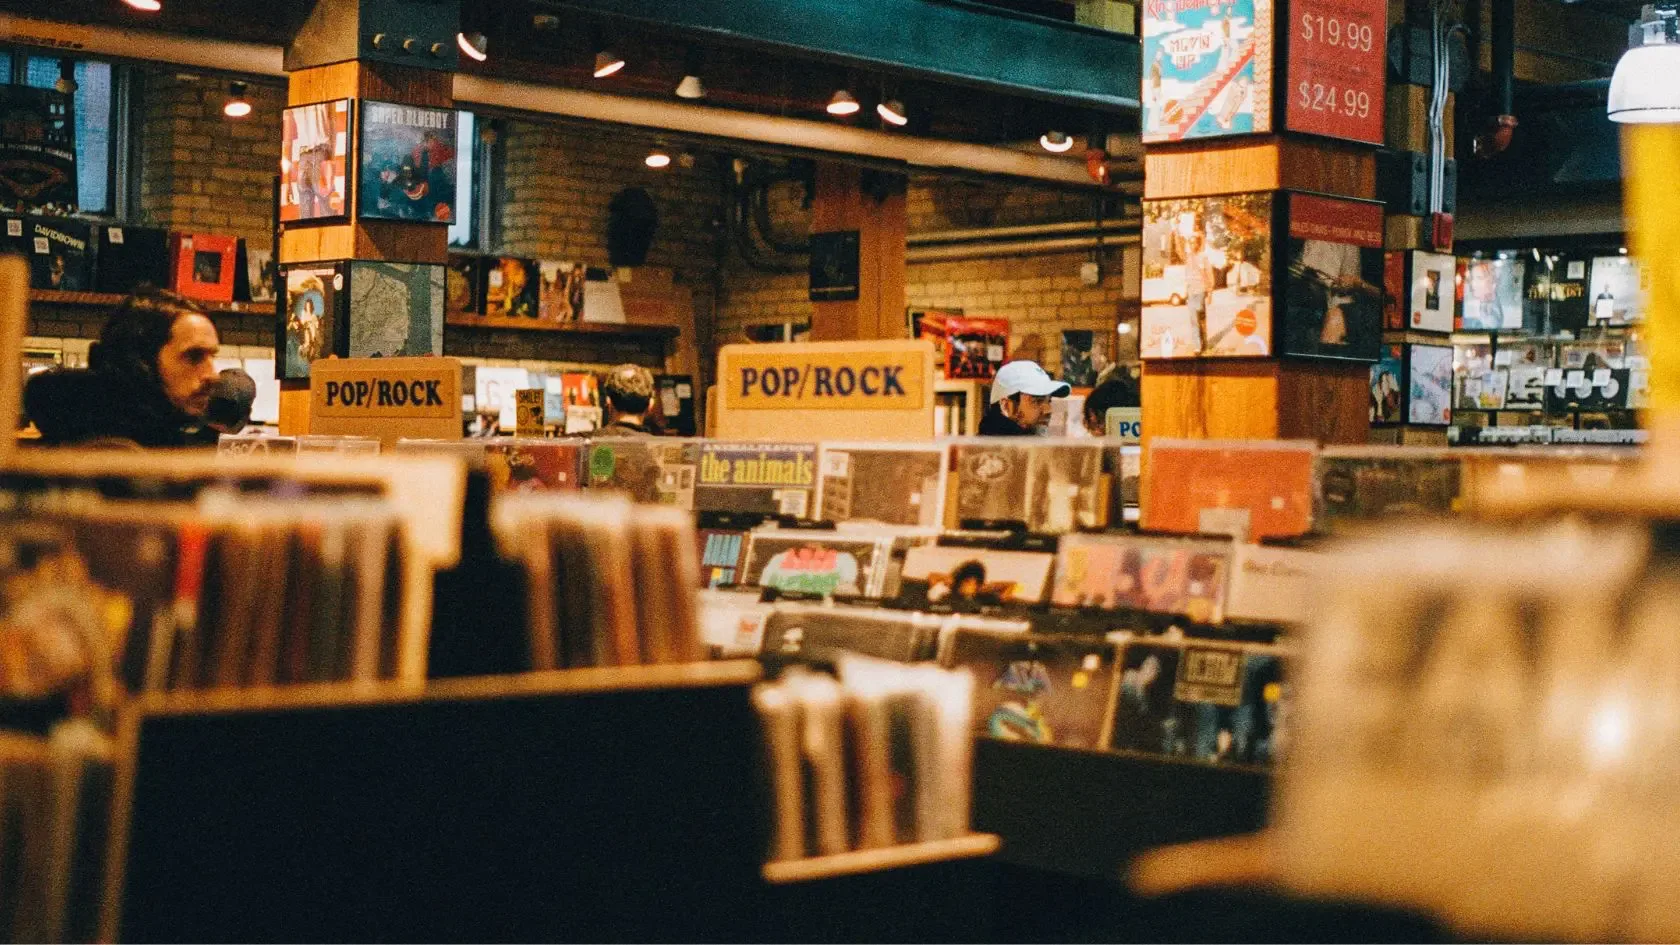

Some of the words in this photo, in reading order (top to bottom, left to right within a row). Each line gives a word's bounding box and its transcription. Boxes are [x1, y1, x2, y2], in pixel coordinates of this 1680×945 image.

[1301, 14, 1373, 52] $19.99
[1299, 81, 1370, 118] $24.99
[326, 378, 443, 408] POP/ROCK
[739, 364, 906, 398] POP/ROCK
[702, 451, 730, 483] the
[734, 452, 813, 485] animals
